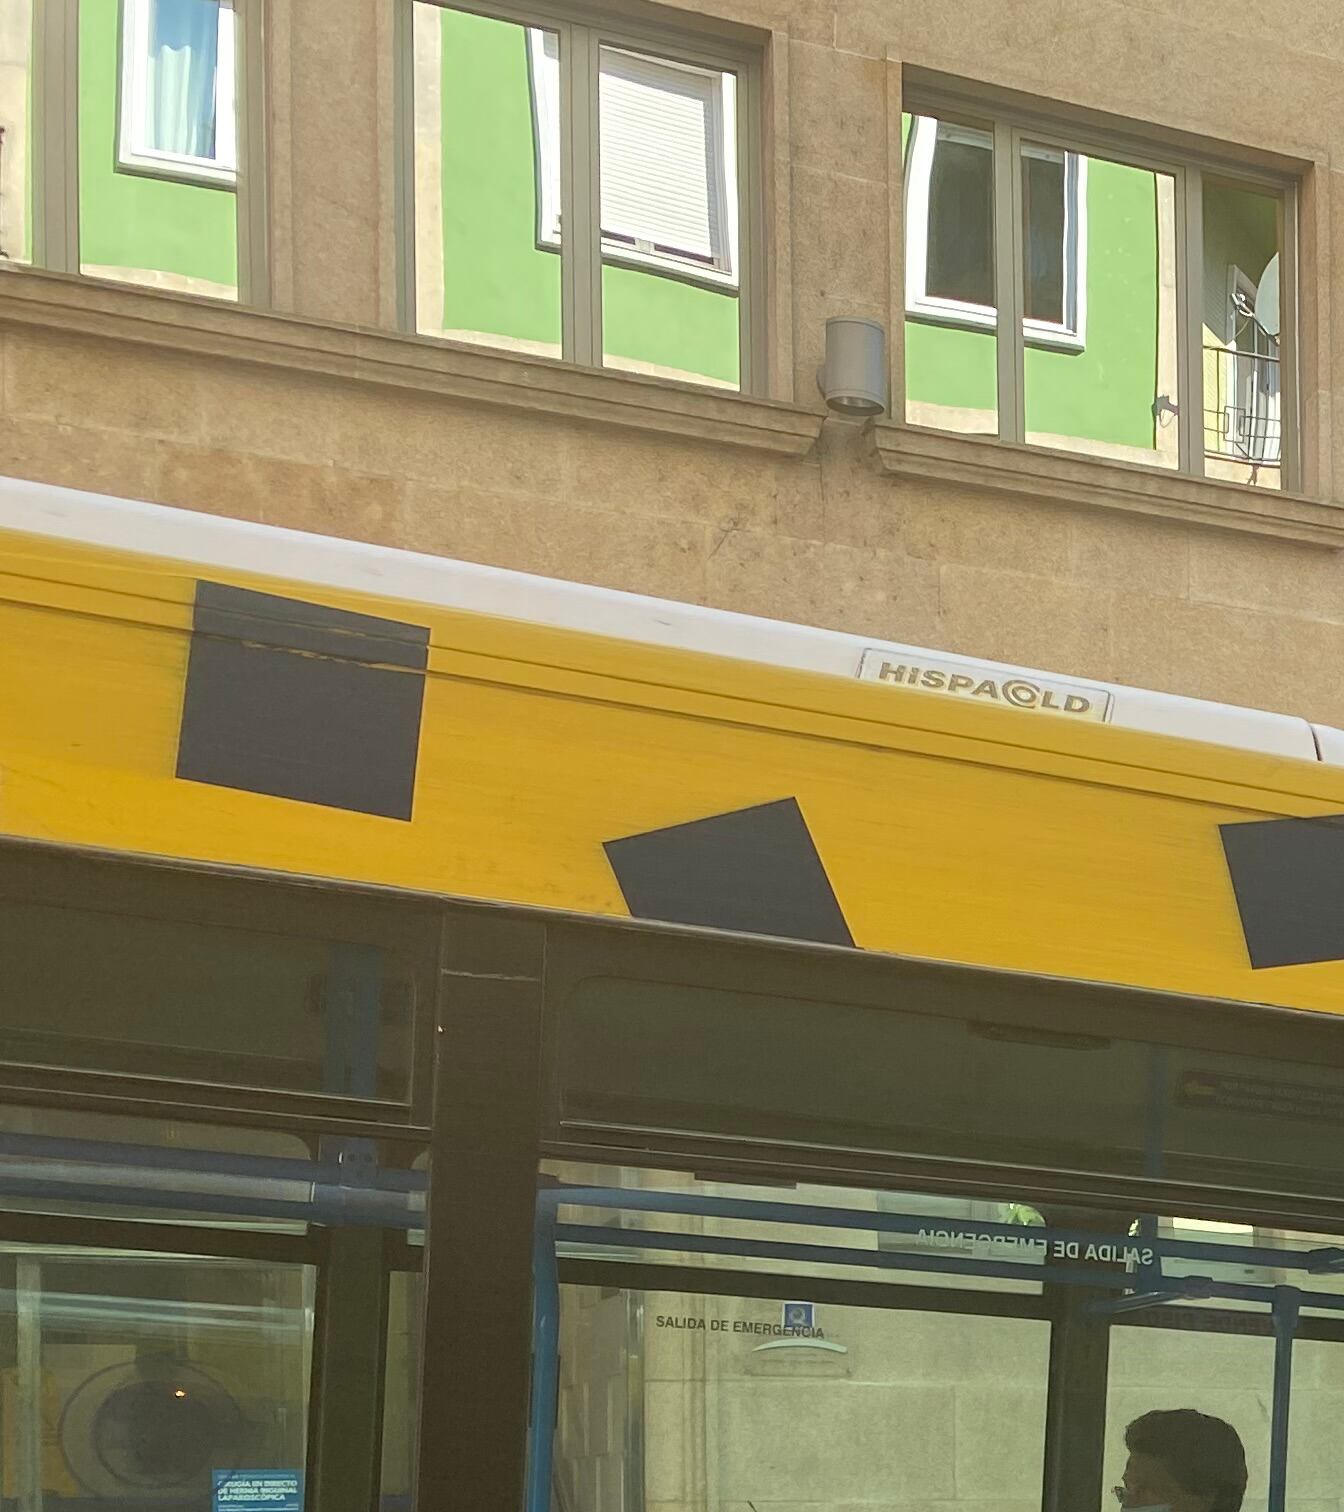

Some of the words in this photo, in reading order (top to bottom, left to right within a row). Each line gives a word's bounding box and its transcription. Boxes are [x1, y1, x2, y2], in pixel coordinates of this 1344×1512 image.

[655, 1315, 706, 1331] SALIDA
[710, 1319, 729, 1332] DE
[733, 1321, 825, 1339] EMERGENCIA
